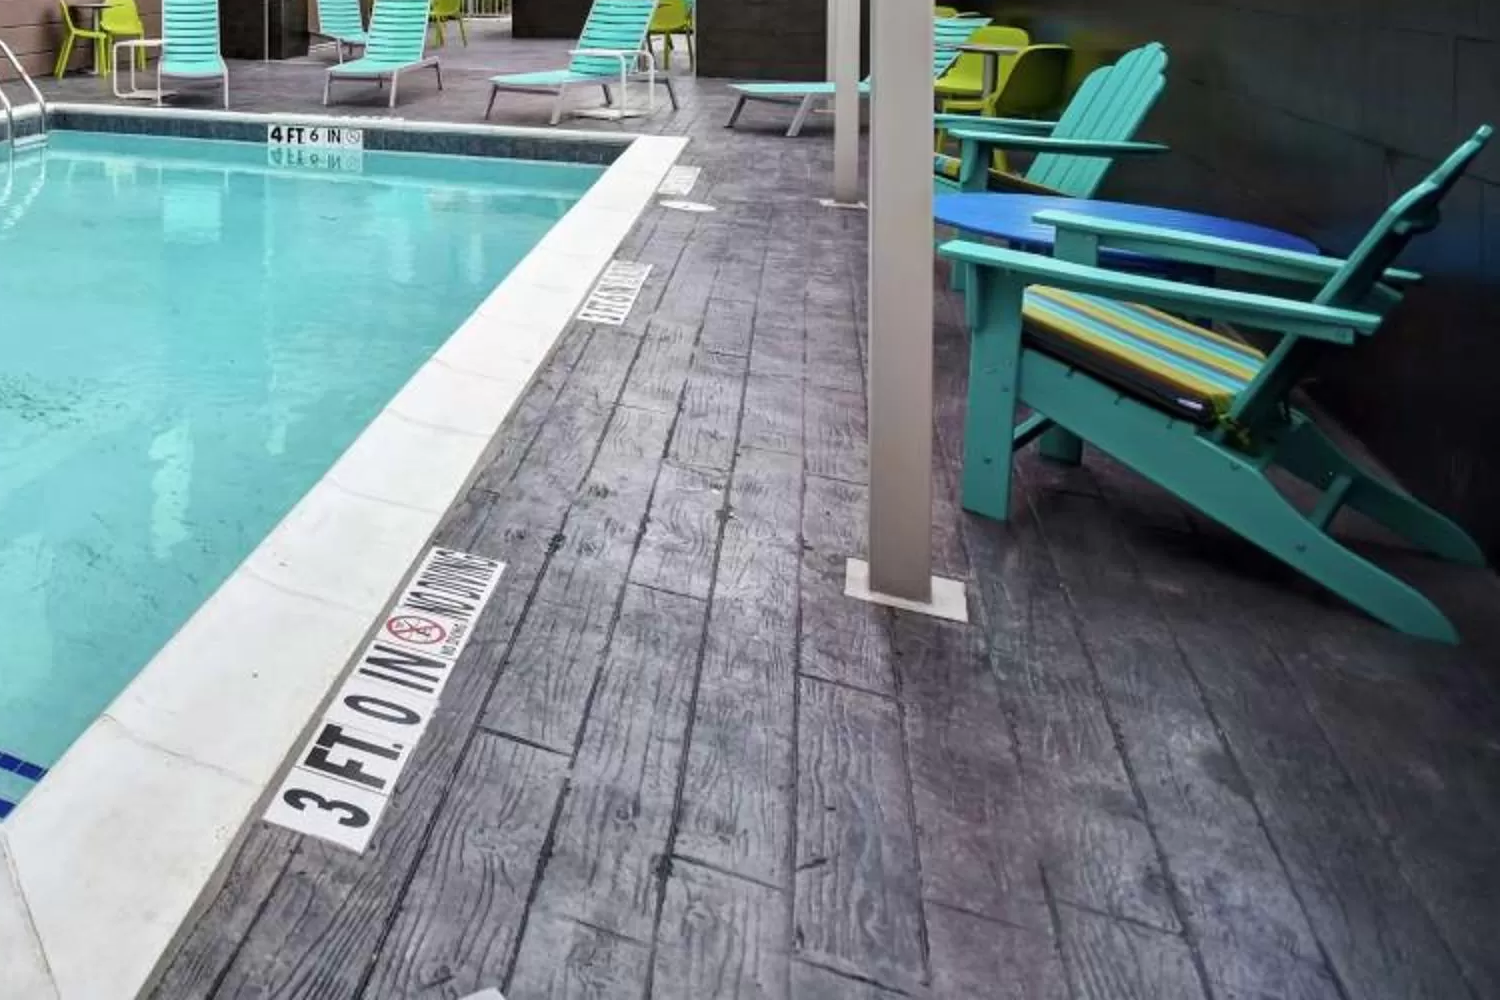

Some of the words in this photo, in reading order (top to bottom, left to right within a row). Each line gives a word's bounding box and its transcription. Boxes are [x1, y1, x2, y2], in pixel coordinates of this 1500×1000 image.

[270, 127, 283, 143] 4
[287, 128, 306, 144] FT
[310, 128, 319, 142] 6
[327, 128, 341, 144] IN
[283, 787, 370, 828] 3
[359, 644, 447, 693] IN
